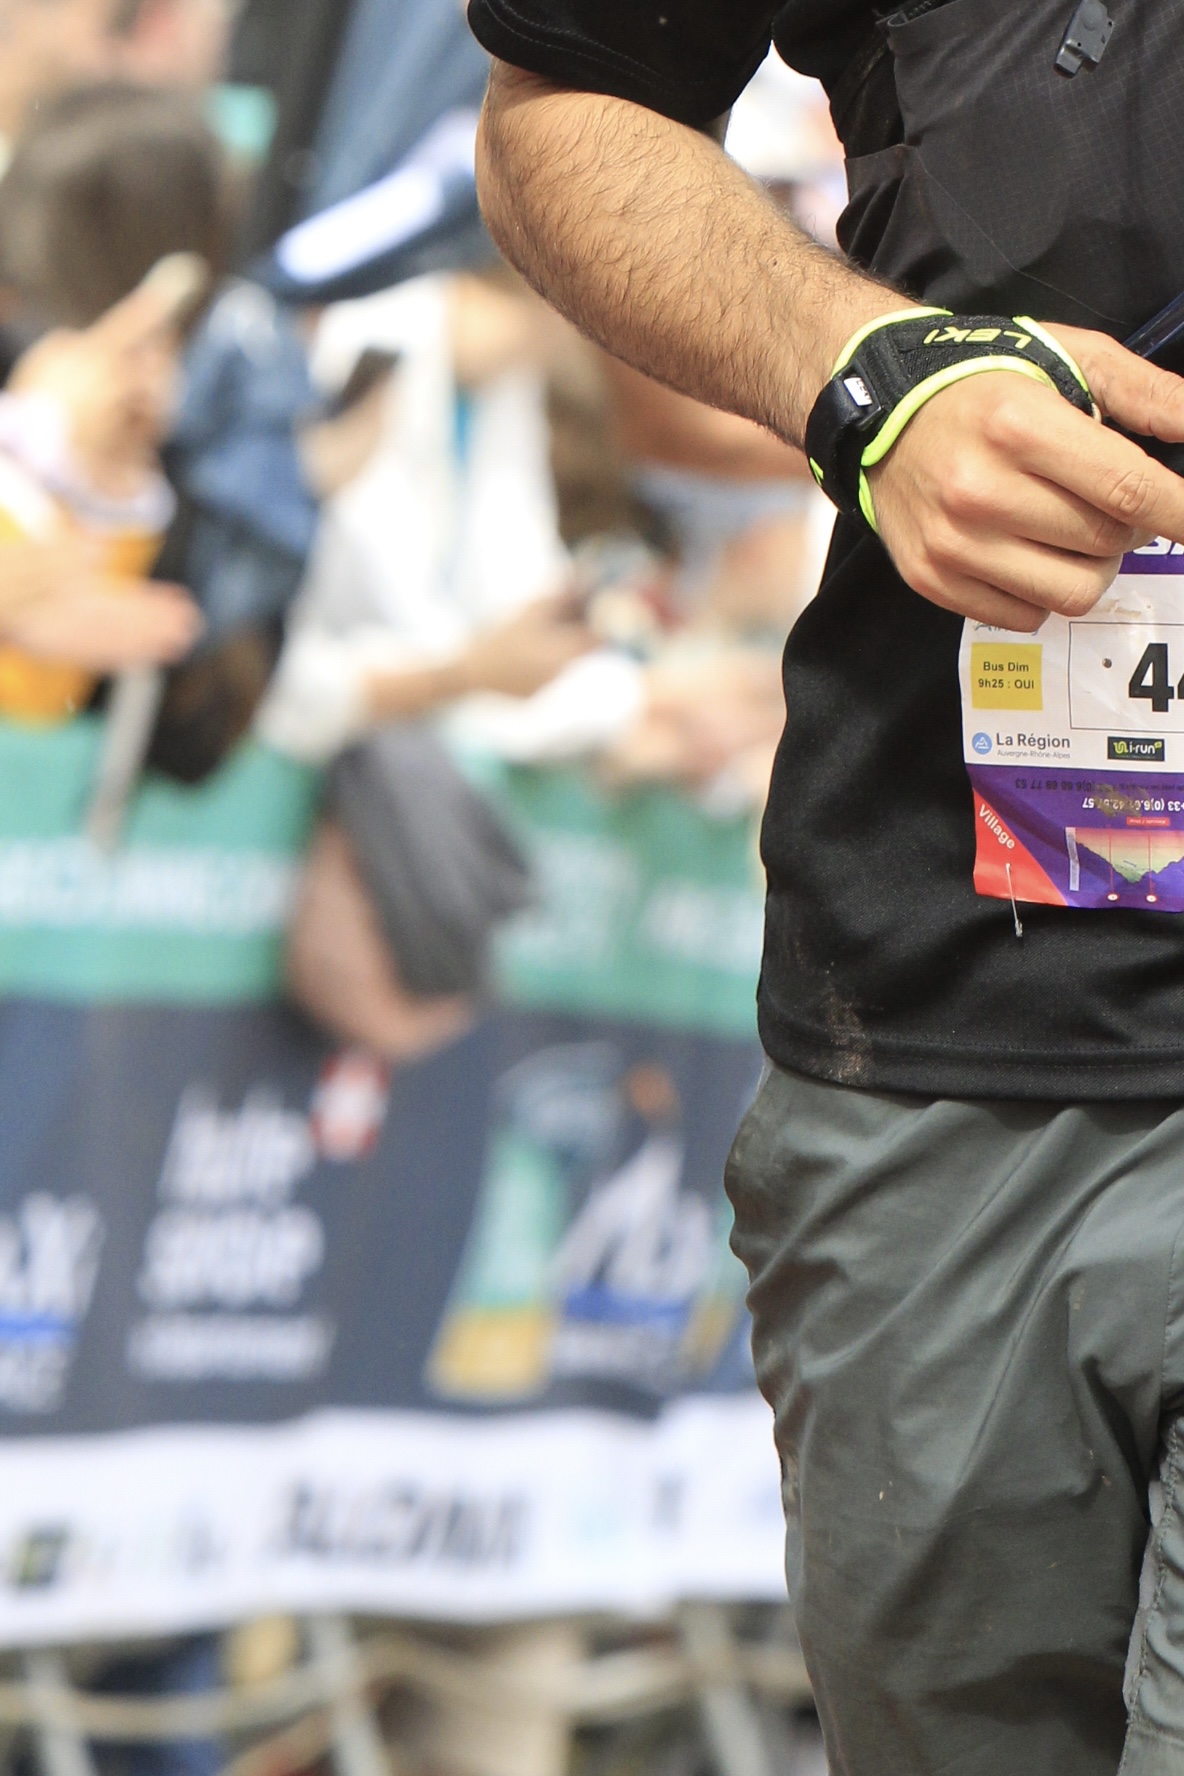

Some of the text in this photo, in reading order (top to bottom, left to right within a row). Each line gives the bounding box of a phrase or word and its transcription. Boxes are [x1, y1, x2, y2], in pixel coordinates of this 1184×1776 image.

[923, 327, 1032, 348] LEKI
[983, 661, 1029, 672] Bus Dim
[978, 678, 1004, 689] 9h25
[1014, 679, 1035, 689] OUI
[996, 733, 1071, 750] La Région
[979, 803, 1015, 849] Village
